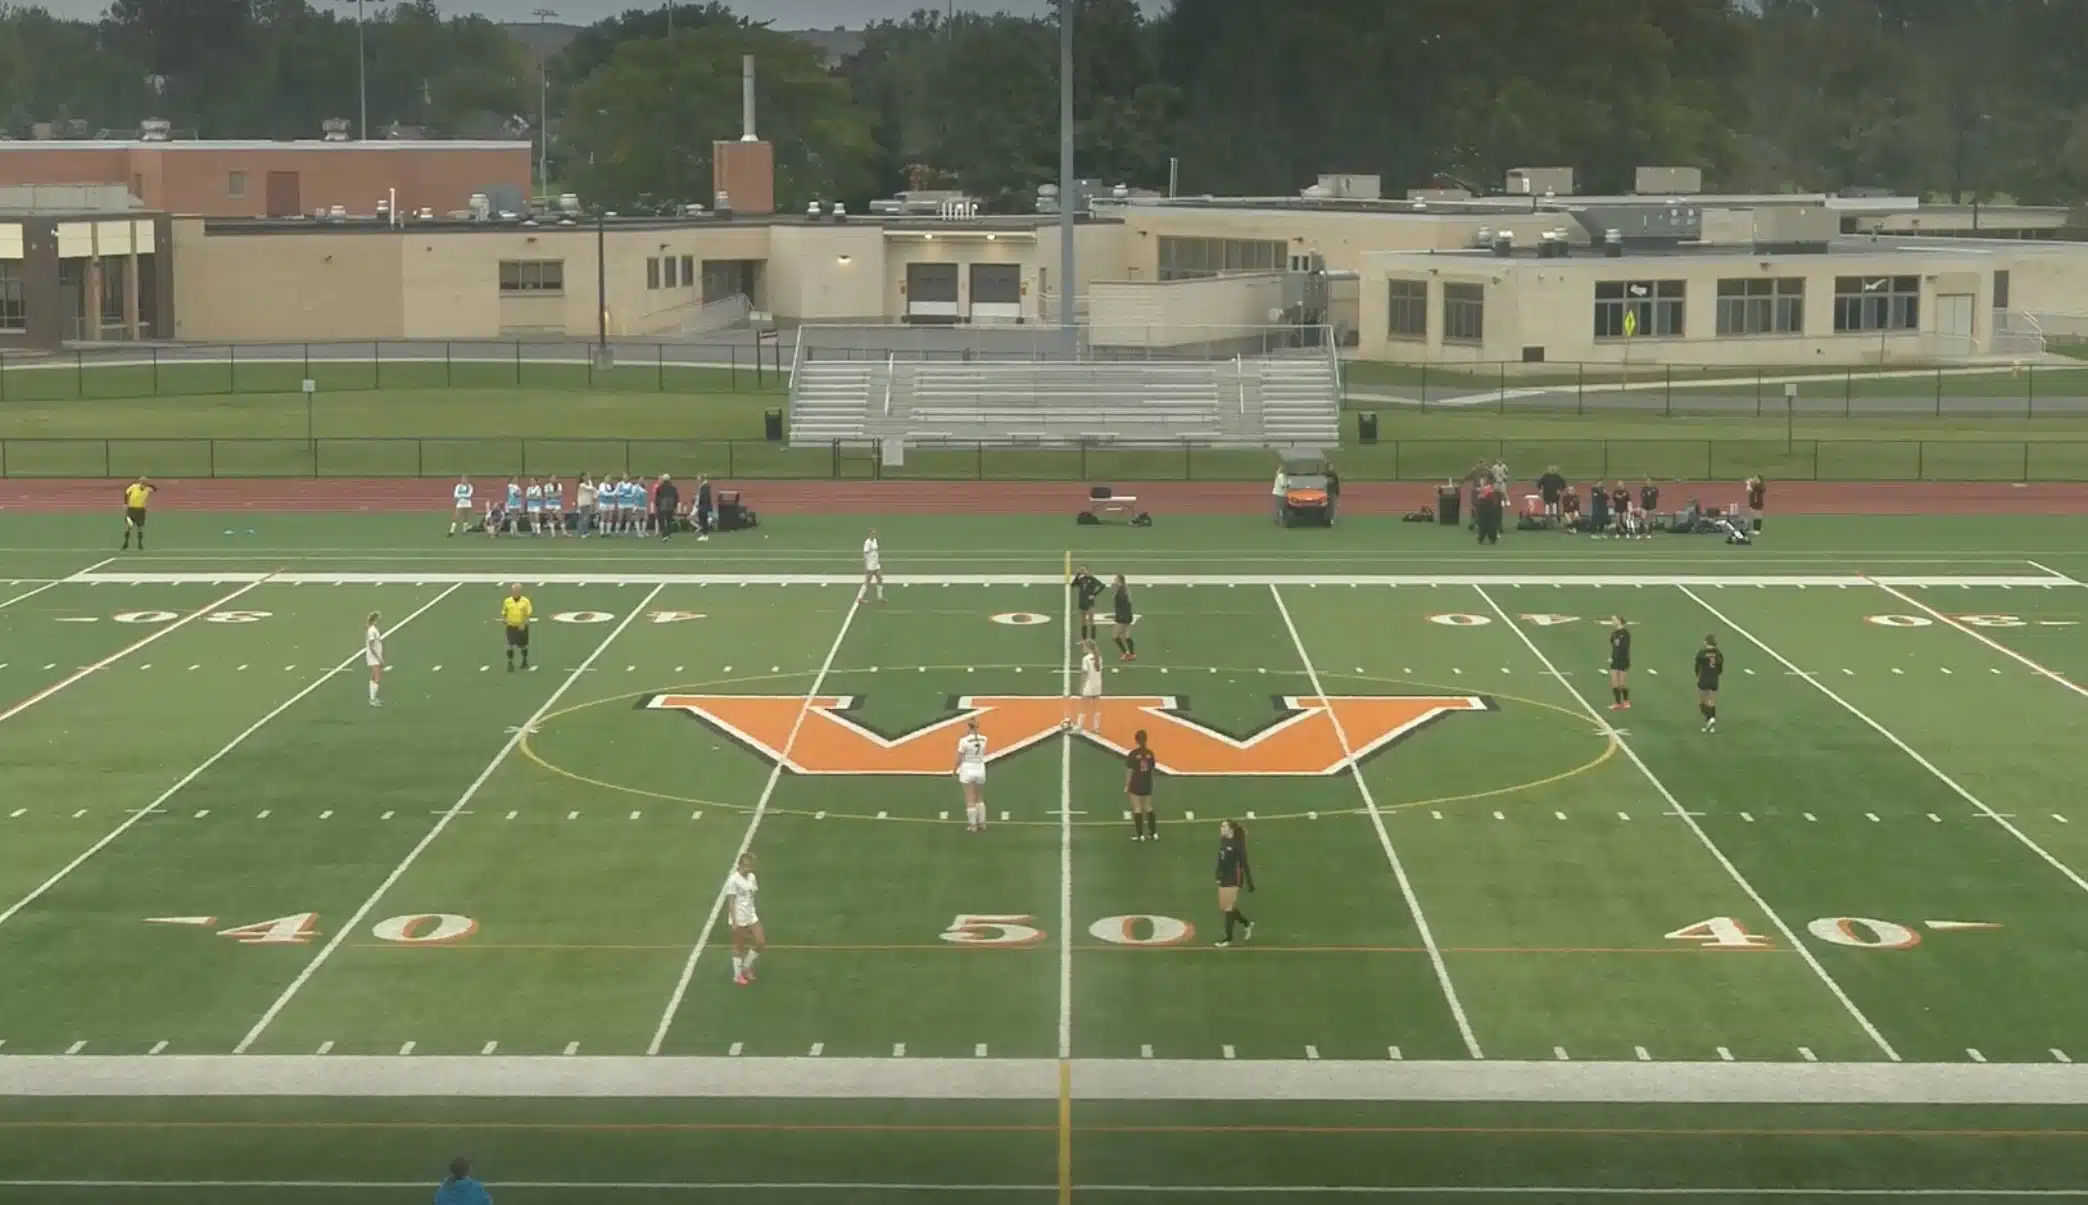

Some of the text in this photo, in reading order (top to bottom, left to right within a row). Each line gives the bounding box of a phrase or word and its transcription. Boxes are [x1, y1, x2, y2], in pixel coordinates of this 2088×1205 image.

[215, 912, 478, 943] 40
[938, 914, 1196, 946] 50
[1664, 917, 1921, 949] 40
